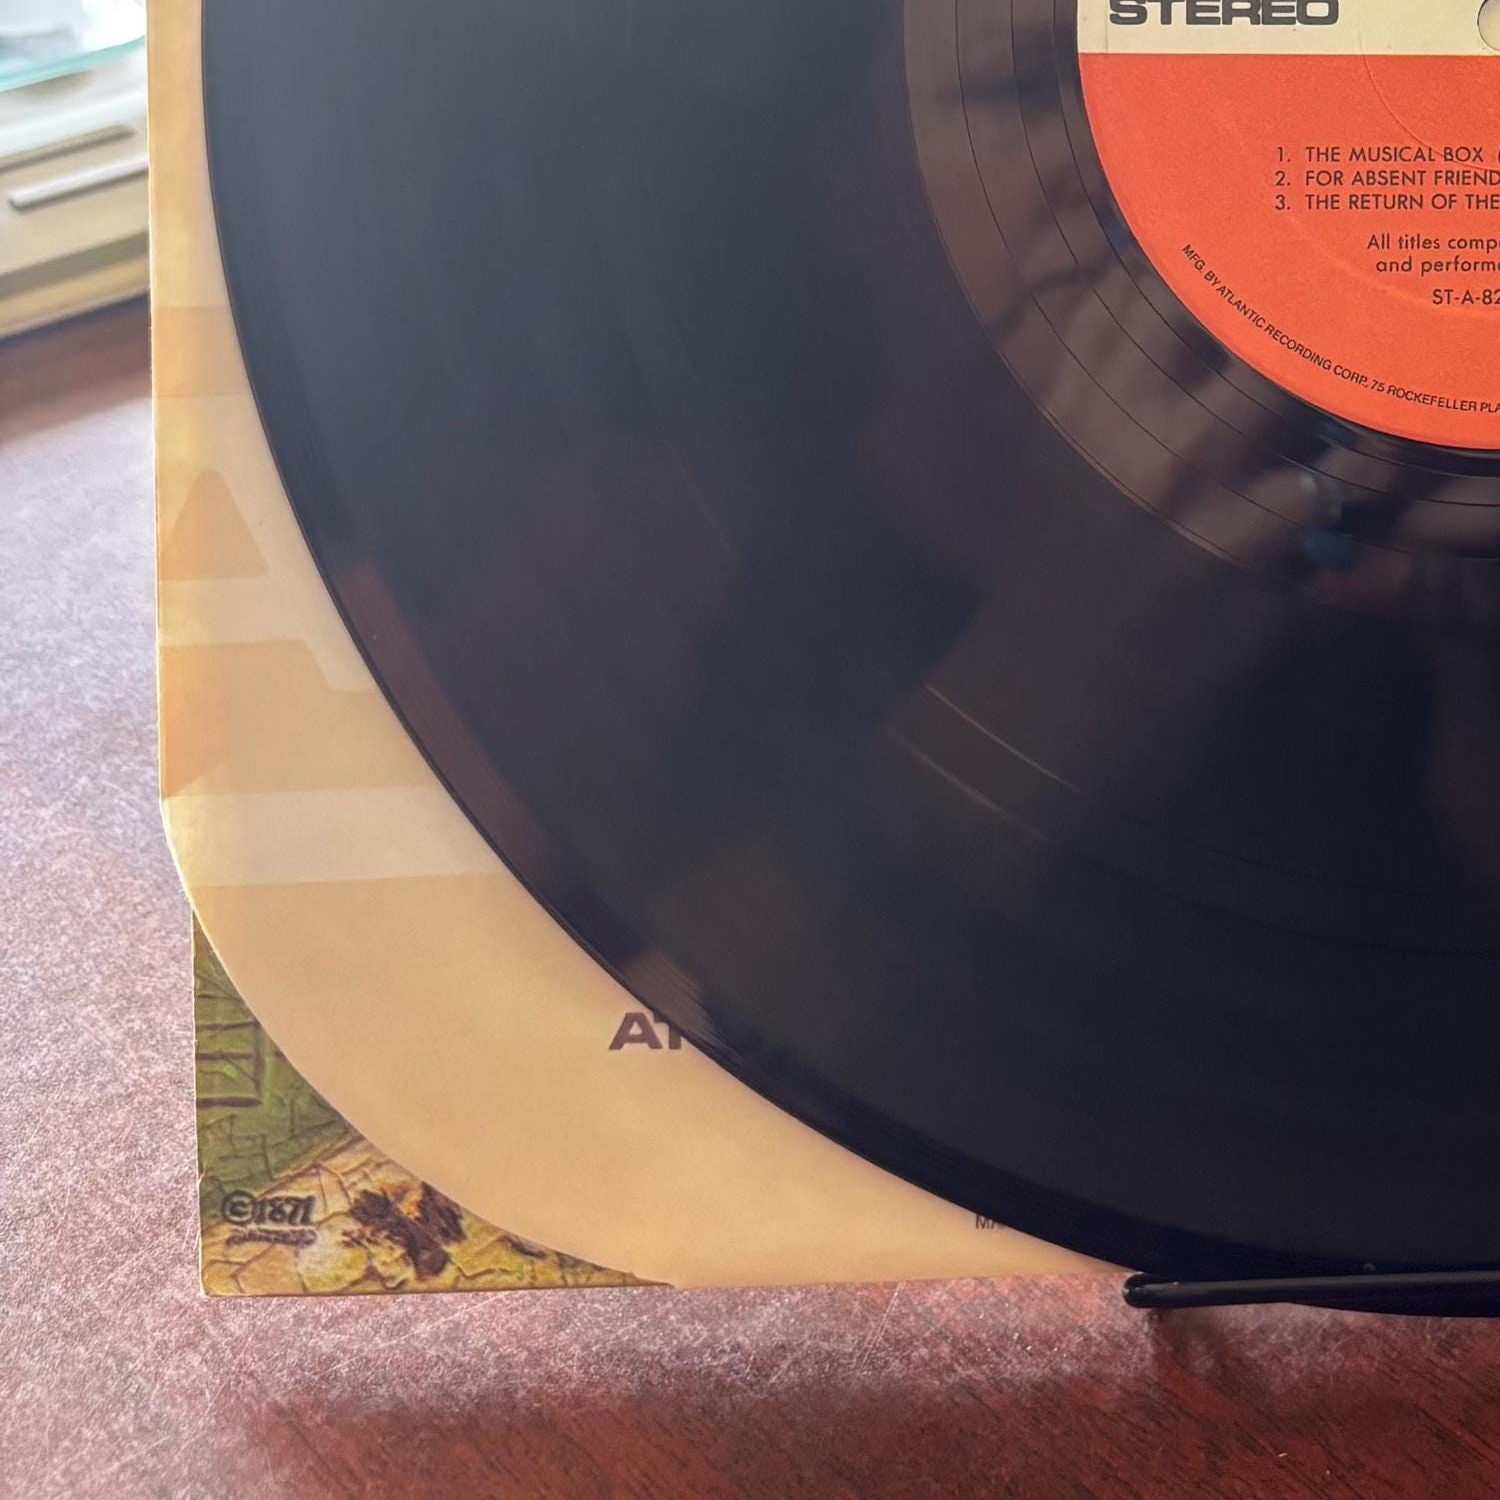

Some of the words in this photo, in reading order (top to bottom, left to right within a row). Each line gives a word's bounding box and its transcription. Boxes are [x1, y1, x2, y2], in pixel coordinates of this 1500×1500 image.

[1277, 146, 1291, 163] 1.
[1306, 146, 1340, 162] THE
[1349, 146, 1435, 162] MUSICAL
[1443, 146, 1483, 163] BOX
[1275, 170, 1291, 186] 2.
[1306, 170, 1343, 186] FOR
[1352, 170, 1426, 186] ABSENT
[1275, 193, 1291, 210] 3.
[1305, 193, 1340, 210] THE
[1349, 193, 1423, 210] RETURN
[1431, 193, 1457, 210] OF
[1465, 193, 1499, 210] THE
[1367, 232, 1390, 249] All
[1399, 233, 1440, 249] titles
[1376, 255, 1412, 272] and
[1204, 271, 1221, 286] BY
[1216, 285, 1266, 328] ATLANTIC
[1264, 324, 1332, 370] RECORDING
[1371, 380, 1385, 392] 75
[1387, 385, 1476, 411] ROCKEFELLER
